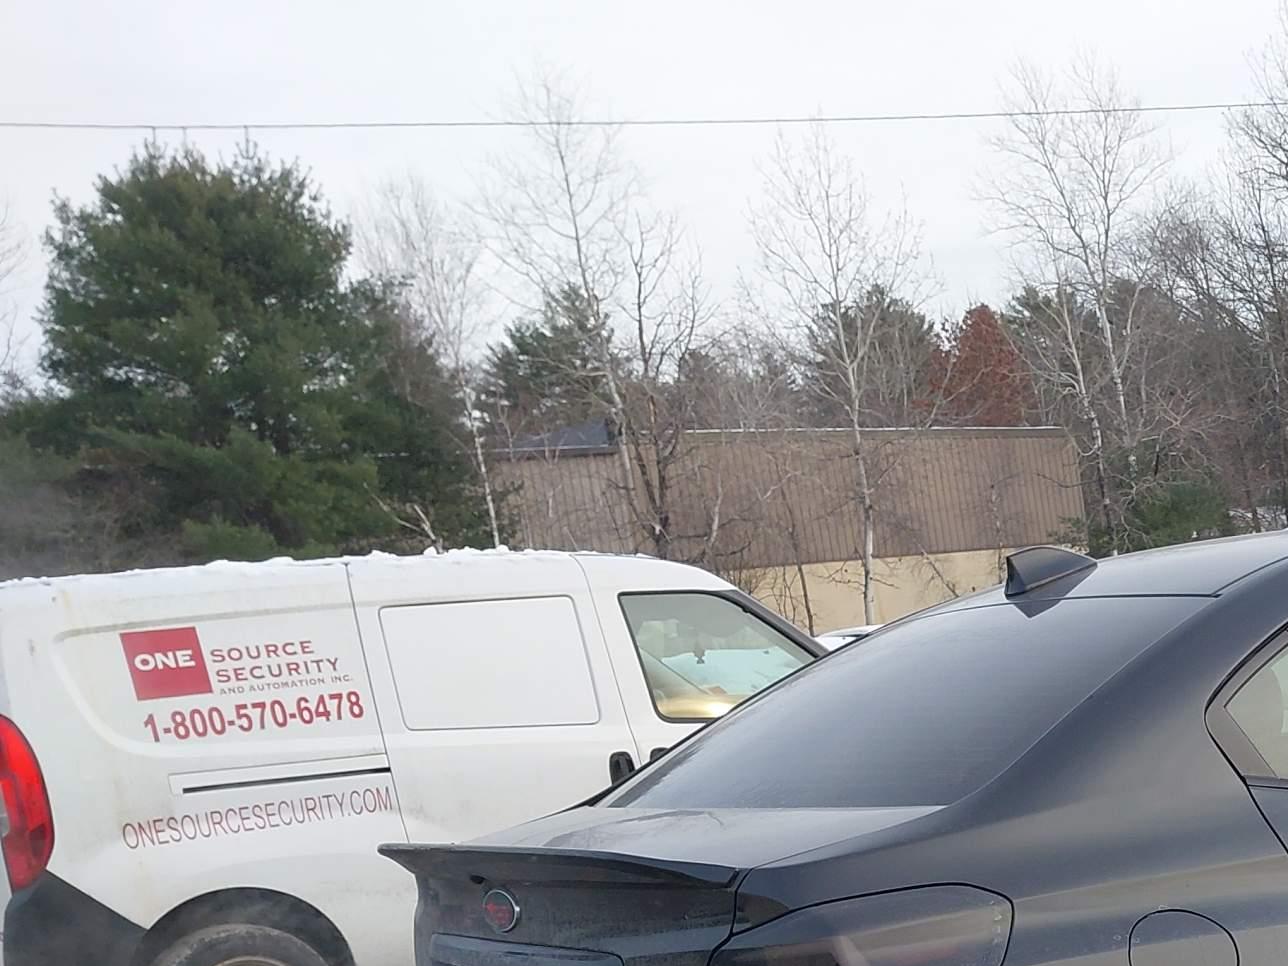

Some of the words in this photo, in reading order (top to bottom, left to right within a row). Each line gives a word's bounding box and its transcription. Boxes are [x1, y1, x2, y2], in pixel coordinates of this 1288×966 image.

[134, 650, 196, 672] ONE
[210, 640, 315, 663] SOURCE
[215, 657, 339, 683] SECURITY
[219, 686, 245, 695] AND
[249, 678, 325, 692] AUTOMATION
[331, 674, 353, 683] INC.
[144, 690, 364, 742] 1-800-570-6478
[122, 786, 393, 850] ONESOURCESECURITY.COM
